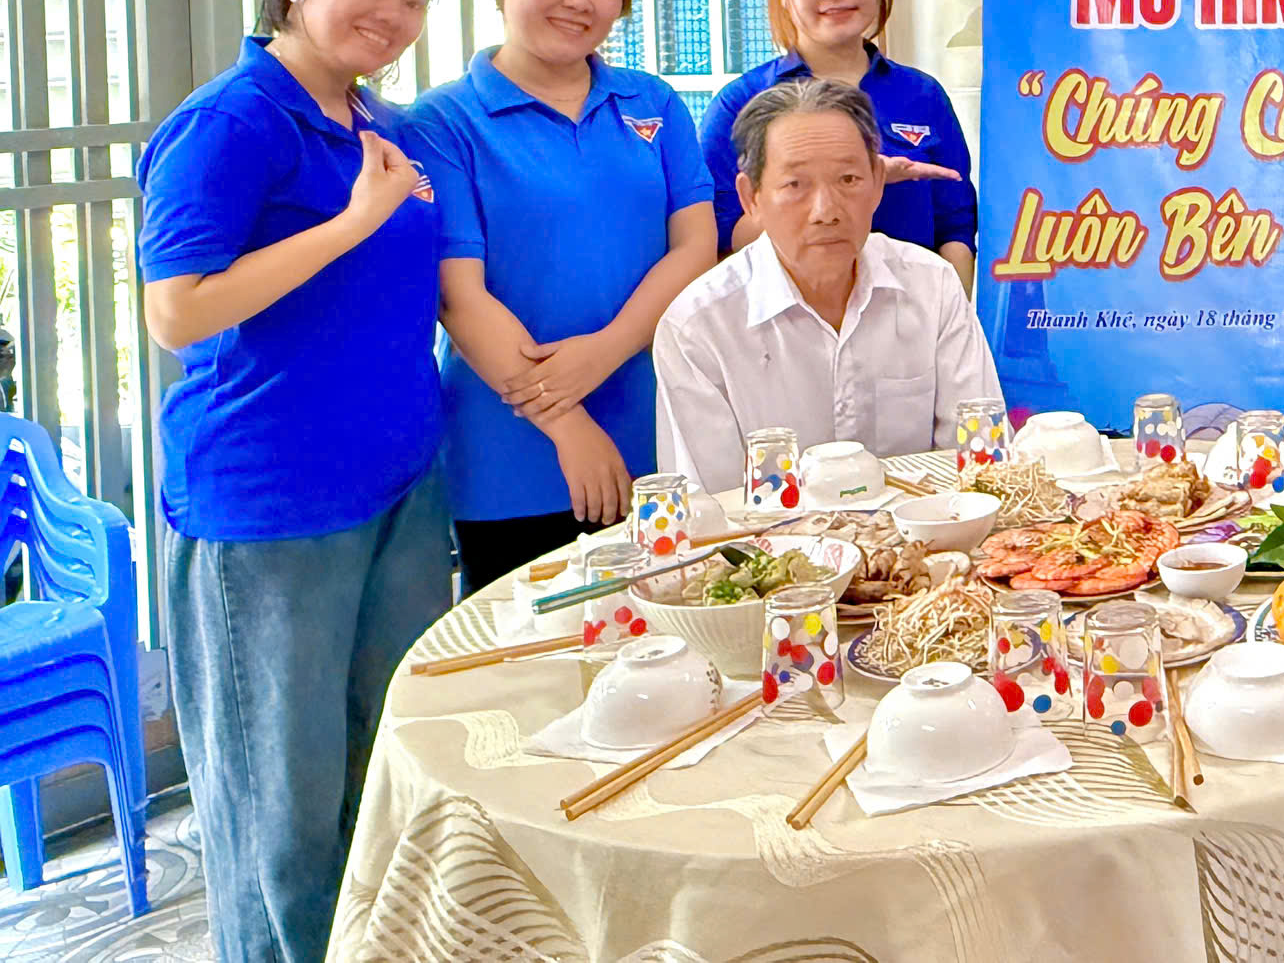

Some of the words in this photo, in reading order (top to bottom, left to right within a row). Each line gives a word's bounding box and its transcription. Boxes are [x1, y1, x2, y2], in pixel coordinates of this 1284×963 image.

[993, 188, 1148, 280] Luôn
[1160, 188, 1283, 281] Bên
[1027, 309, 1088, 329] Thanh
[1095, 310, 1137, 329] Khê,
[1143, 310, 1189, 332] ngày
[1196, 309, 1218, 327] 18
[1222, 309, 1276, 331] tháng
